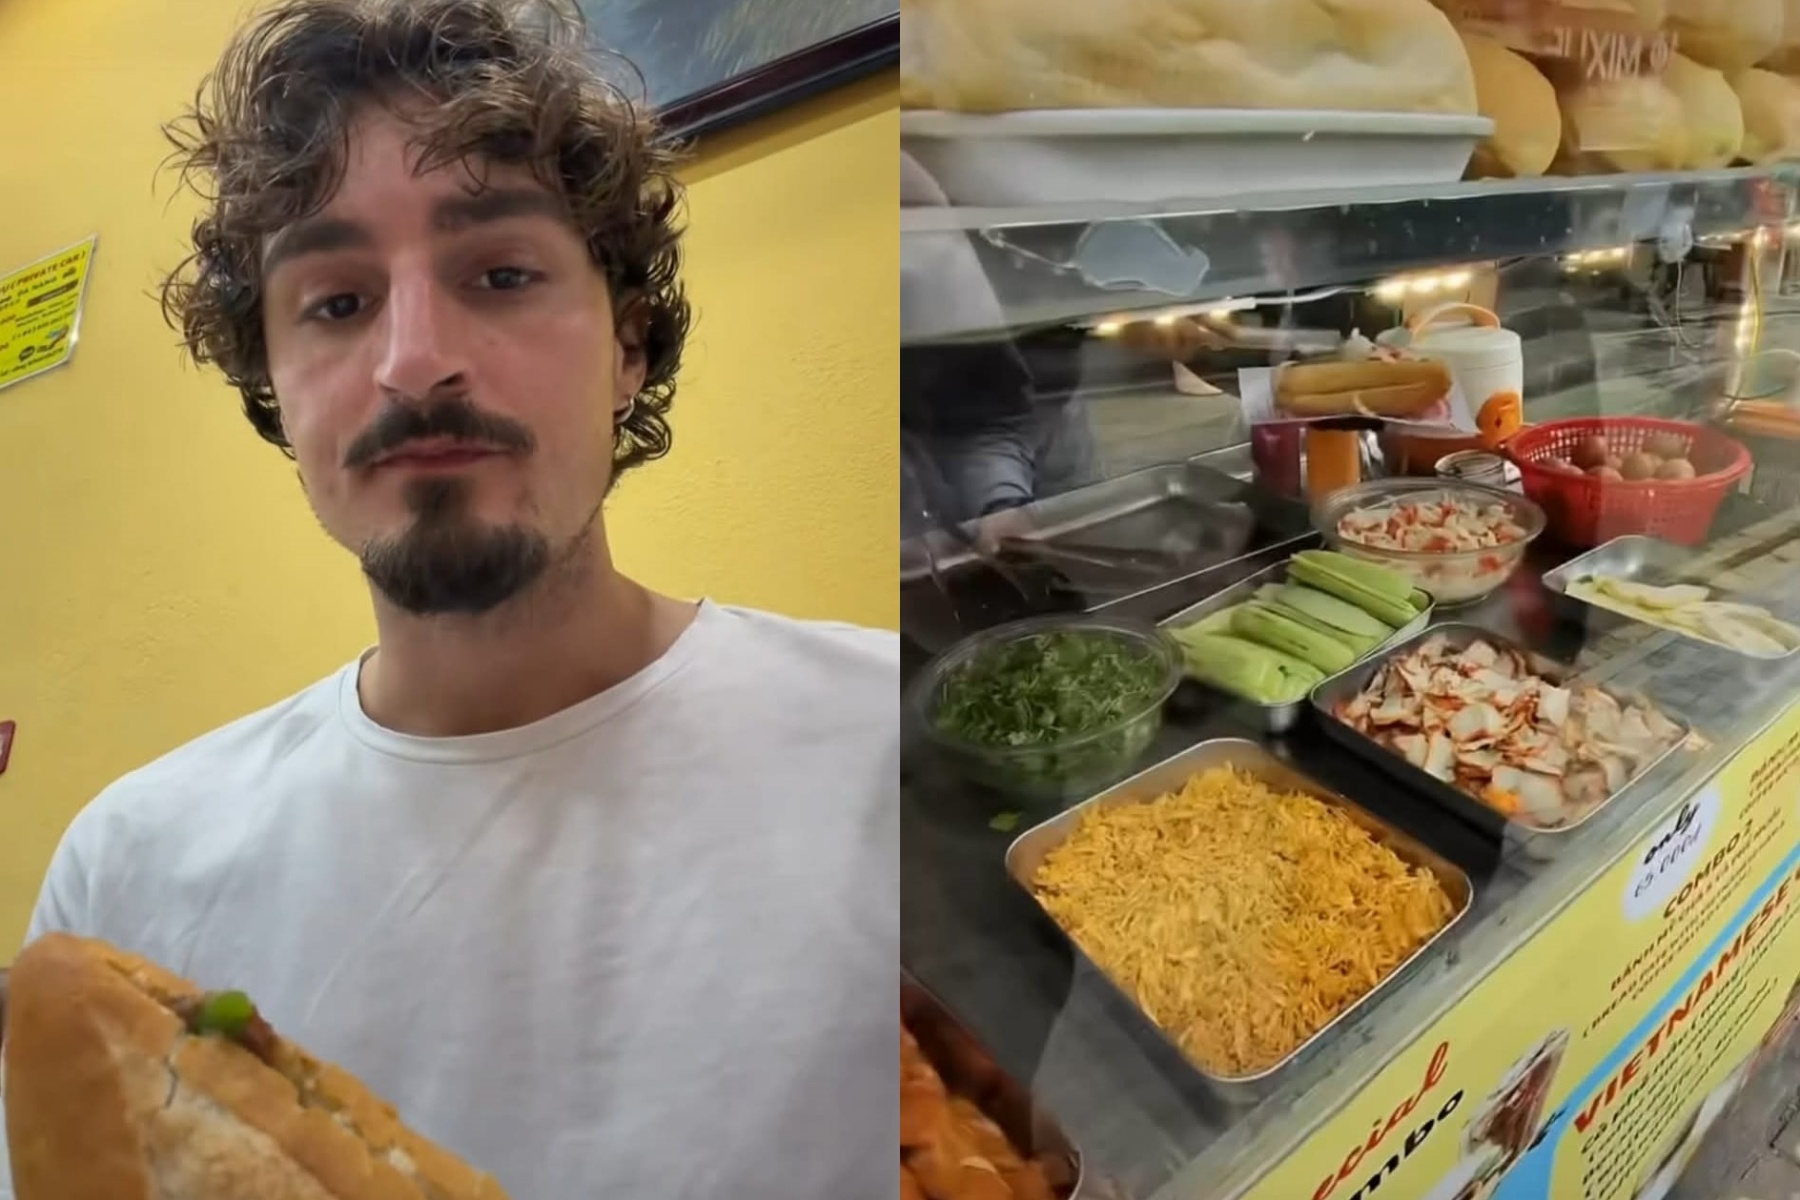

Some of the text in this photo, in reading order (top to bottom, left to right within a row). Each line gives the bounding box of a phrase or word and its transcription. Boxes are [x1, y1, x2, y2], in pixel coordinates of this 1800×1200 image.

[1643, 802, 1701, 865] only
[1663, 832, 1740, 919] COMBO
[1573, 875, 1791, 1134] VIETNAMESE
